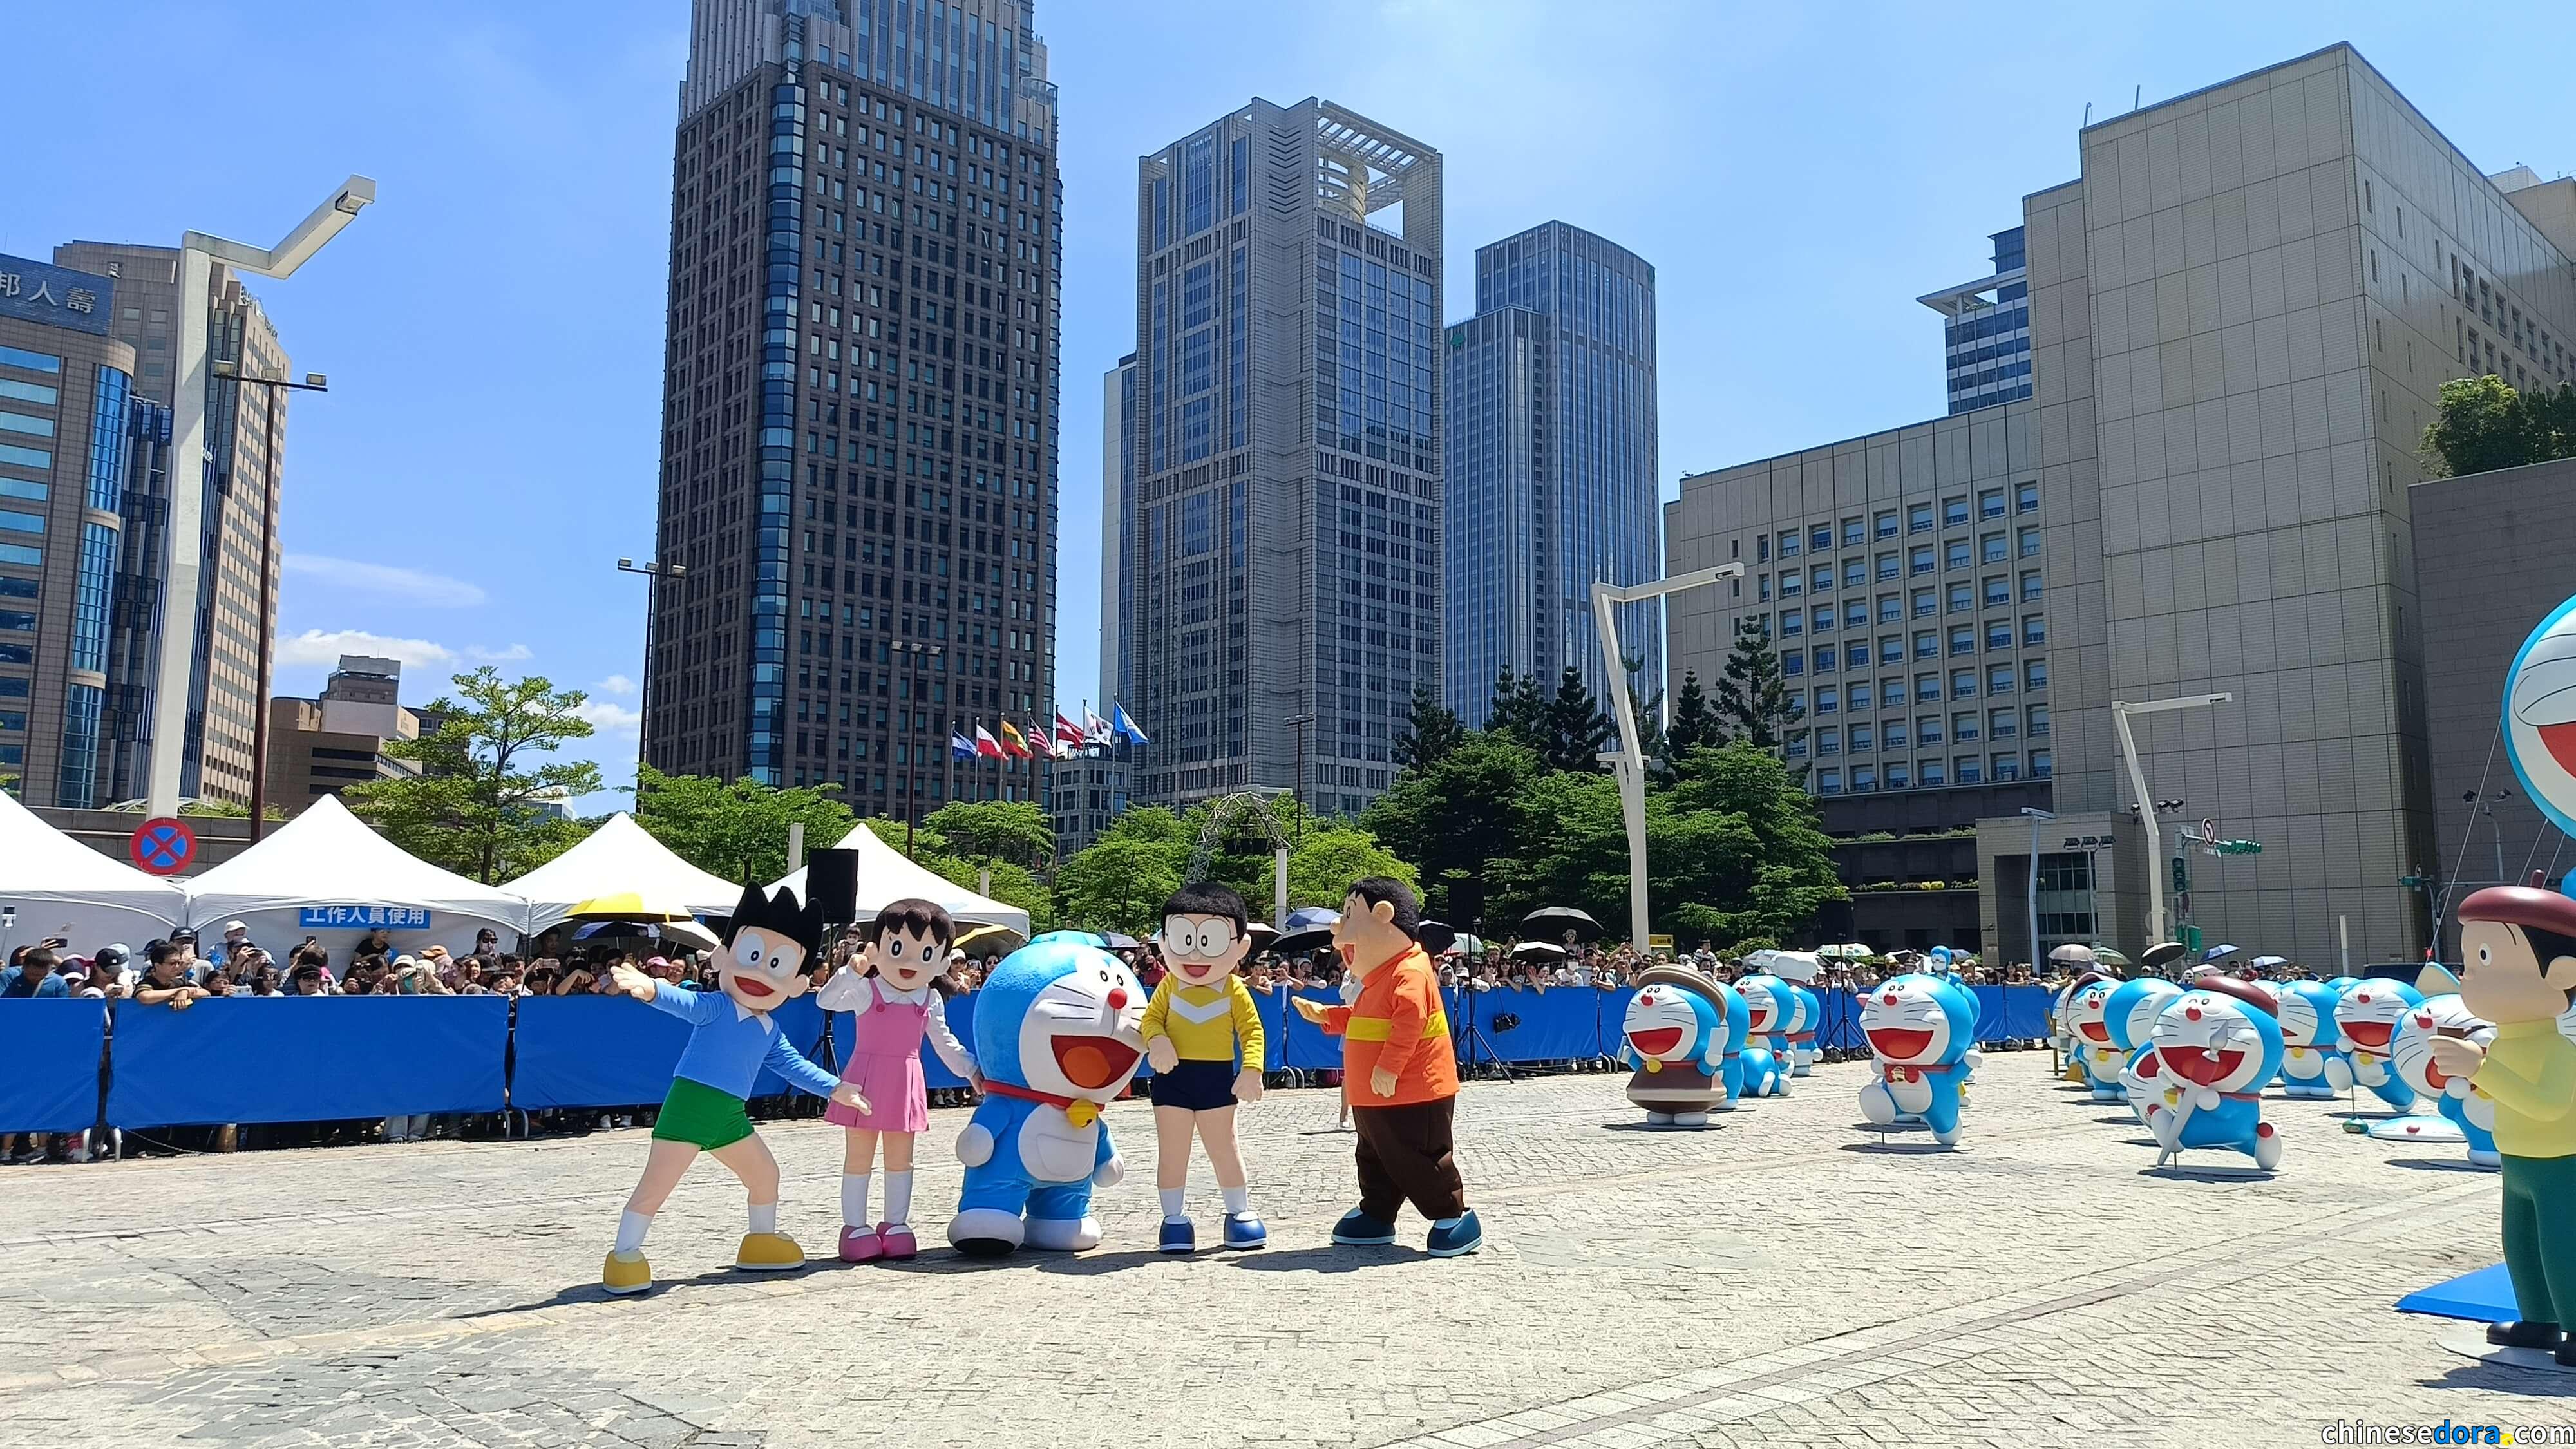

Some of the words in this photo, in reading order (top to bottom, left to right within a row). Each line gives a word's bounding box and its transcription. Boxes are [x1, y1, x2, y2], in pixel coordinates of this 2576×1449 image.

[305, 907, 425, 925] 工作人員使用
